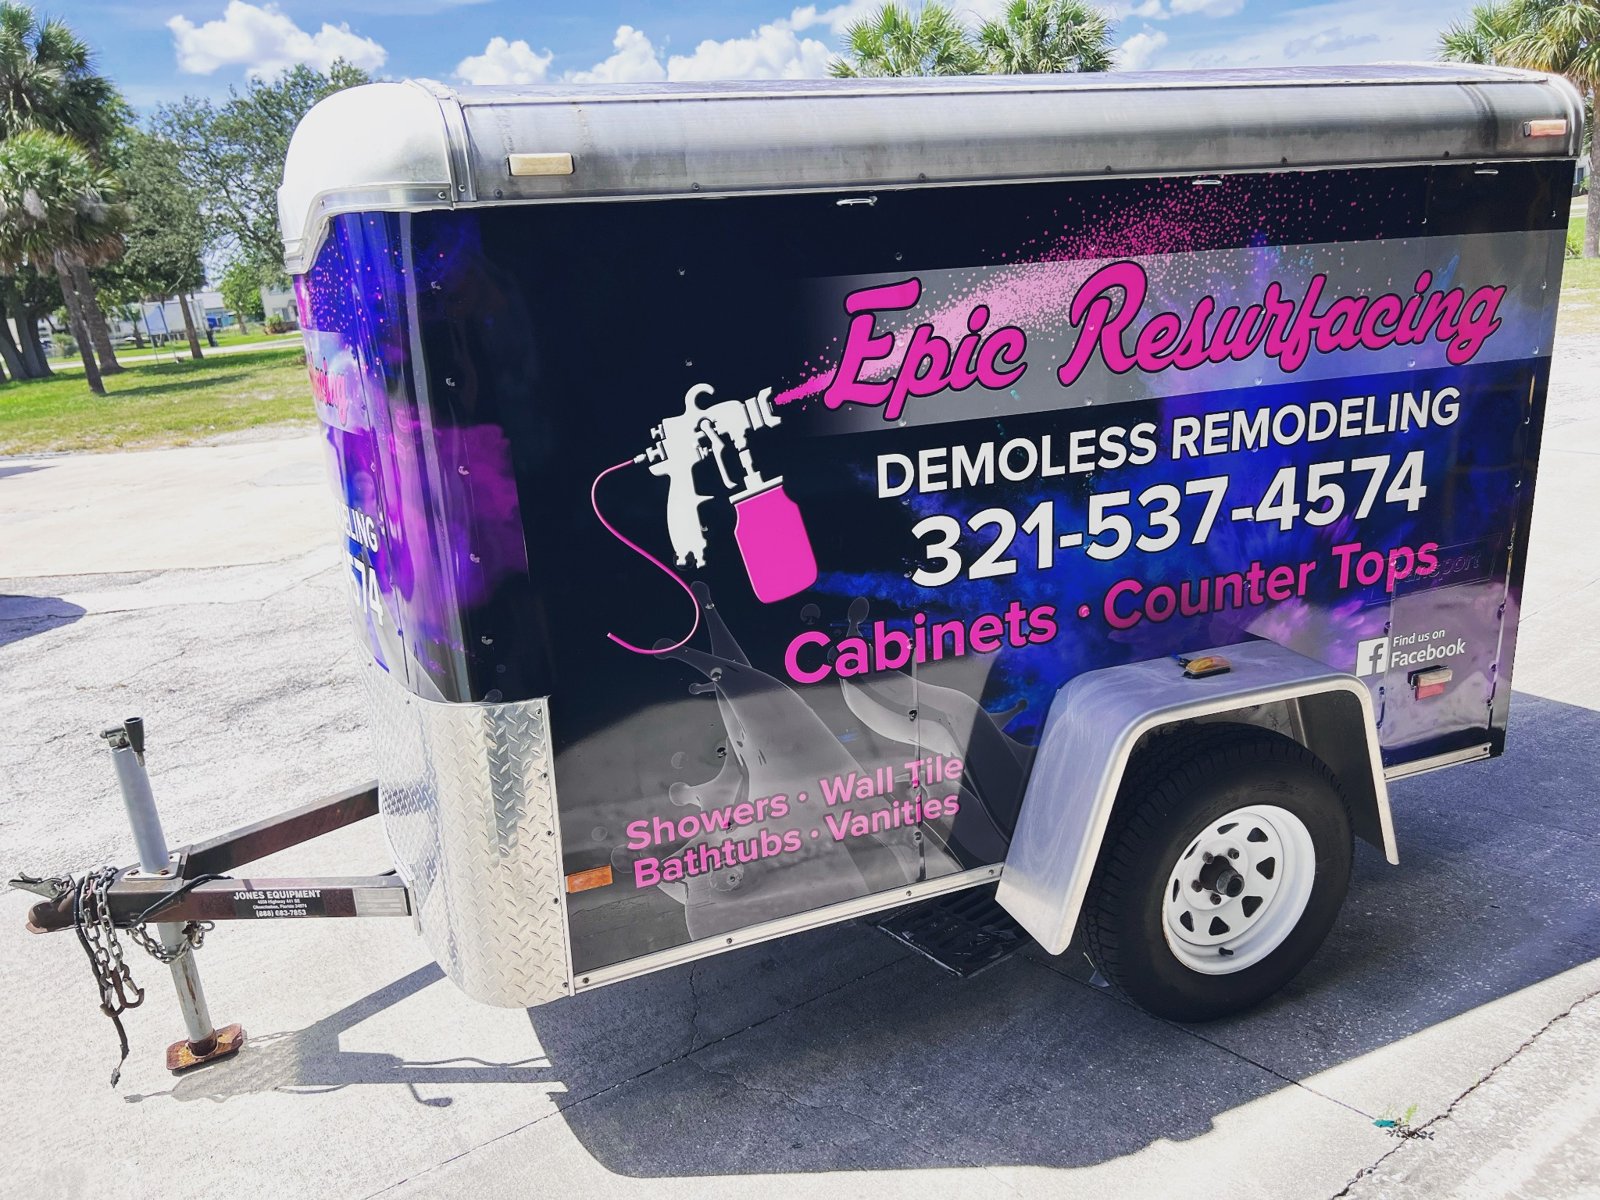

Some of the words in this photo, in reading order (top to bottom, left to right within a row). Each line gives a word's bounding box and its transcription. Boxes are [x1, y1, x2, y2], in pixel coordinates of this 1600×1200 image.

[824, 277, 1028, 421] Epic
[1057, 260, 1506, 387] Resurfacing
[877, 425, 1157, 500] DEMOLESS
[1172, 387, 1461, 462] REMODELING
[910, 451, 1427, 588] 321-537-4574
[785, 601, 1057, 684] Cabinets
[1104, 559, 1316, 630] Counter
[1332, 542, 1439, 592] Tops
[1391, 637, 1466, 668] Facebook
[1393, 632, 1415, 647] Find
[1418, 631, 1430, 641] us
[1432, 630, 1446, 640] on
[626, 793, 789, 850] Showers
[819, 766, 894, 807] Wall
[904, 755, 964, 789] Tile
[633, 829, 801, 889] Bathtubs
[825, 792, 961, 842] Vanities
[233, 891, 265, 900] JONES
[266, 890, 321, 899] EQUIPMENT
